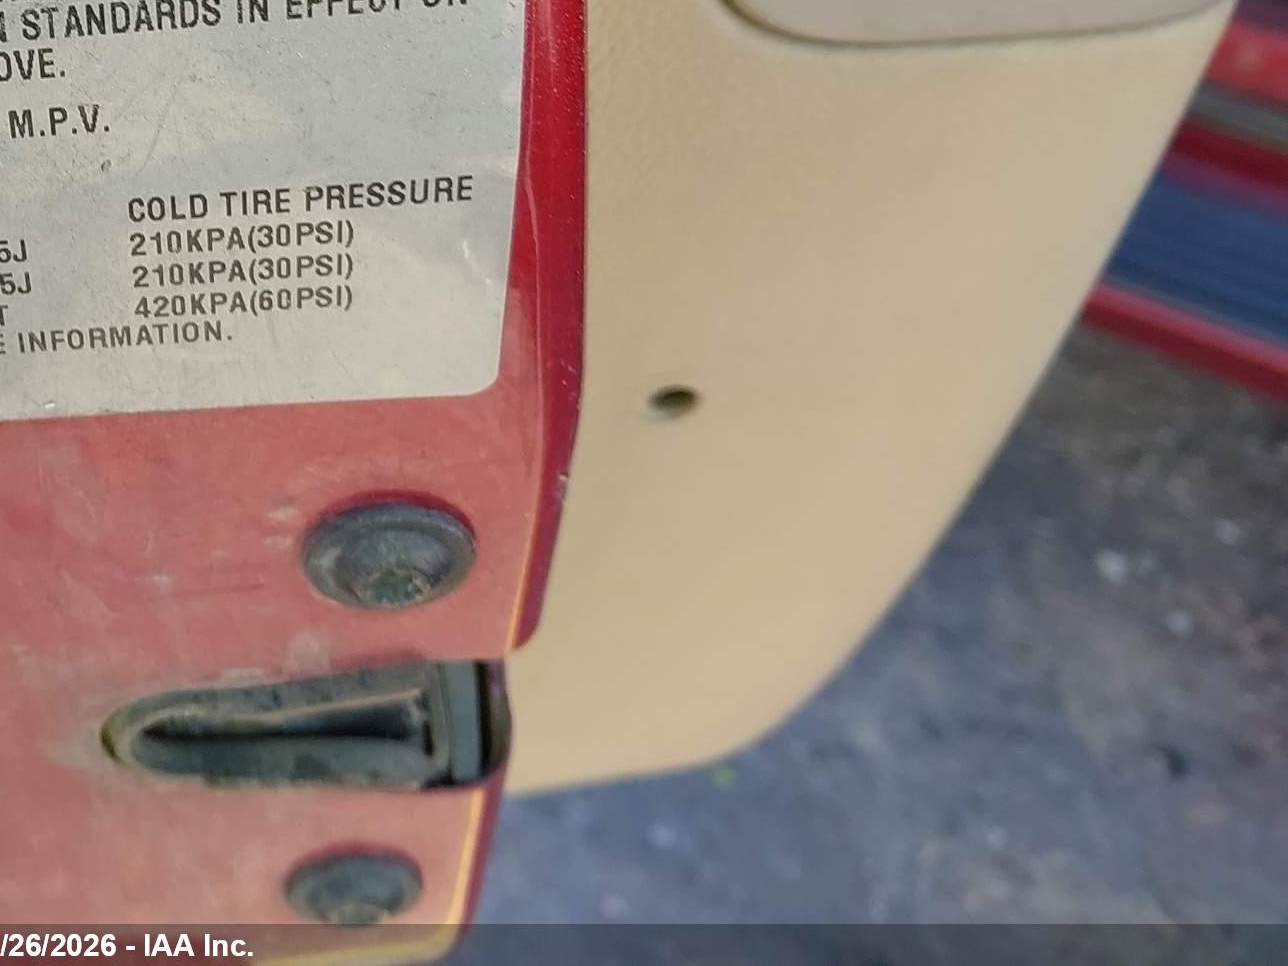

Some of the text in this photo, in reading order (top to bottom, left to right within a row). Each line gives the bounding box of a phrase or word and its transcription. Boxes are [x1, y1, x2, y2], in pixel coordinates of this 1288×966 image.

[8, 105, 109, 139] M.P.V.
[128, 175, 474, 222] COLD TIRE PRESSURE
[130, 221, 354, 257] 210KPA(30PSI)
[132, 254, 354, 289] 210KPA(30PSI)
[135, 286, 354, 319] 420KPA(60PSI)
[18, 321, 233, 354] INFORMATION.
